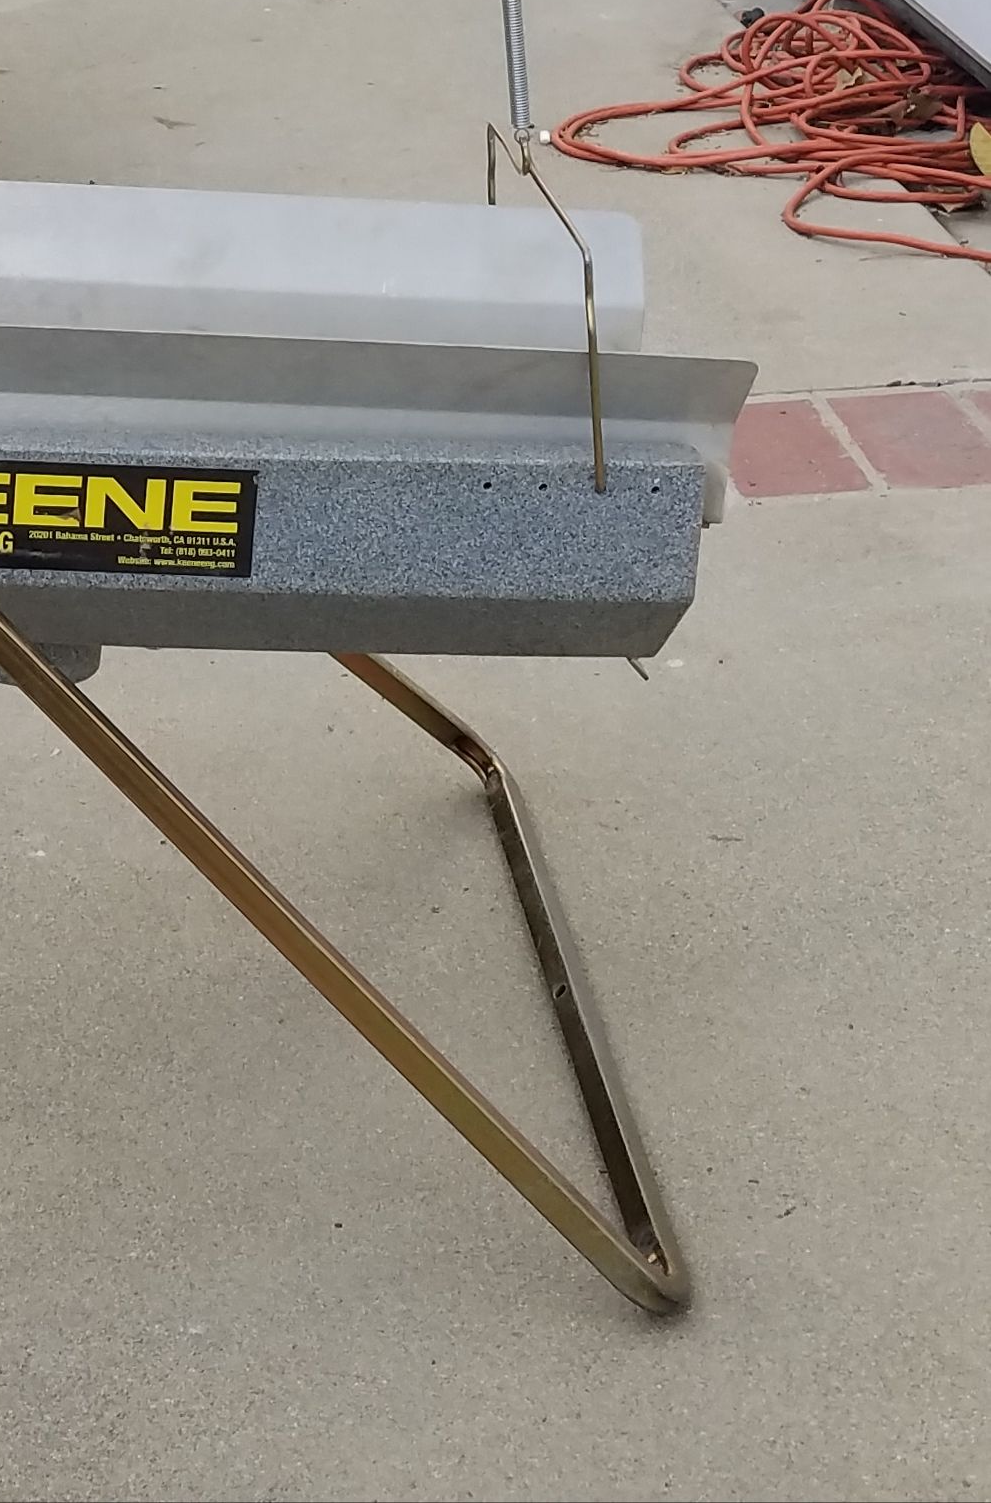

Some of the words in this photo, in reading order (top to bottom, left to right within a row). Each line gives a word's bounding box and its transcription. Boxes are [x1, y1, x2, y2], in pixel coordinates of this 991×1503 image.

[28, 530, 53, 539] 20201
[90, 532, 115, 542] Street
[174, 535, 185, 544] CA
[212, 537, 236, 547] U.S.A.
[160, 546, 174, 555] Tel:
